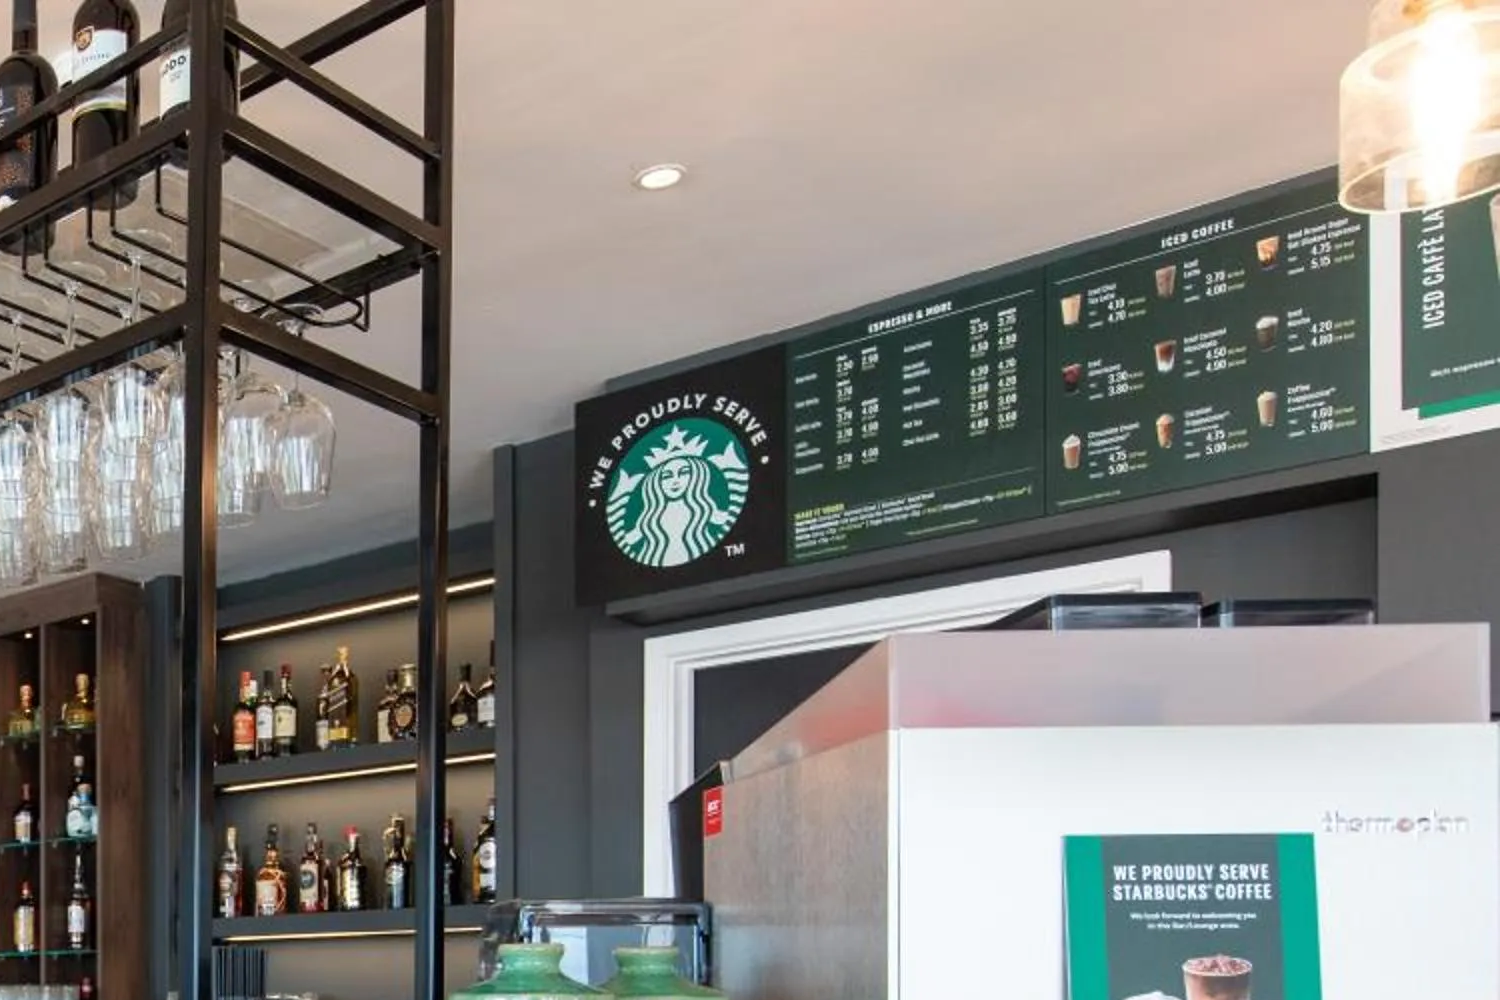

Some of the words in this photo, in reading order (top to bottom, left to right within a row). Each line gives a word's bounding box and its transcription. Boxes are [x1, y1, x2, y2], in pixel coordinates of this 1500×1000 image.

[1161, 232, 1188, 248] ICED
[1191, 218, 1235, 239] COFFEE
[1417, 234, 1445, 287] CAFFÈ
[1205, 284, 1227, 297] 4.00
[925, 301, 952, 316] MORE
[1422, 289, 1445, 329] ICED
[589, 456, 613, 489] WE
[611, 393, 707, 450] PROUDLY
[712, 397, 768, 446] SERVE
[724, 543, 745, 558] TM
[1322, 808, 1469, 841] thermoplan
[1113, 864, 1137, 881] WE
[1141, 864, 1214, 881] PROUDLY
[1219, 863, 1269, 880] SERVE
[1215, 883, 1272, 900] COFFEE
